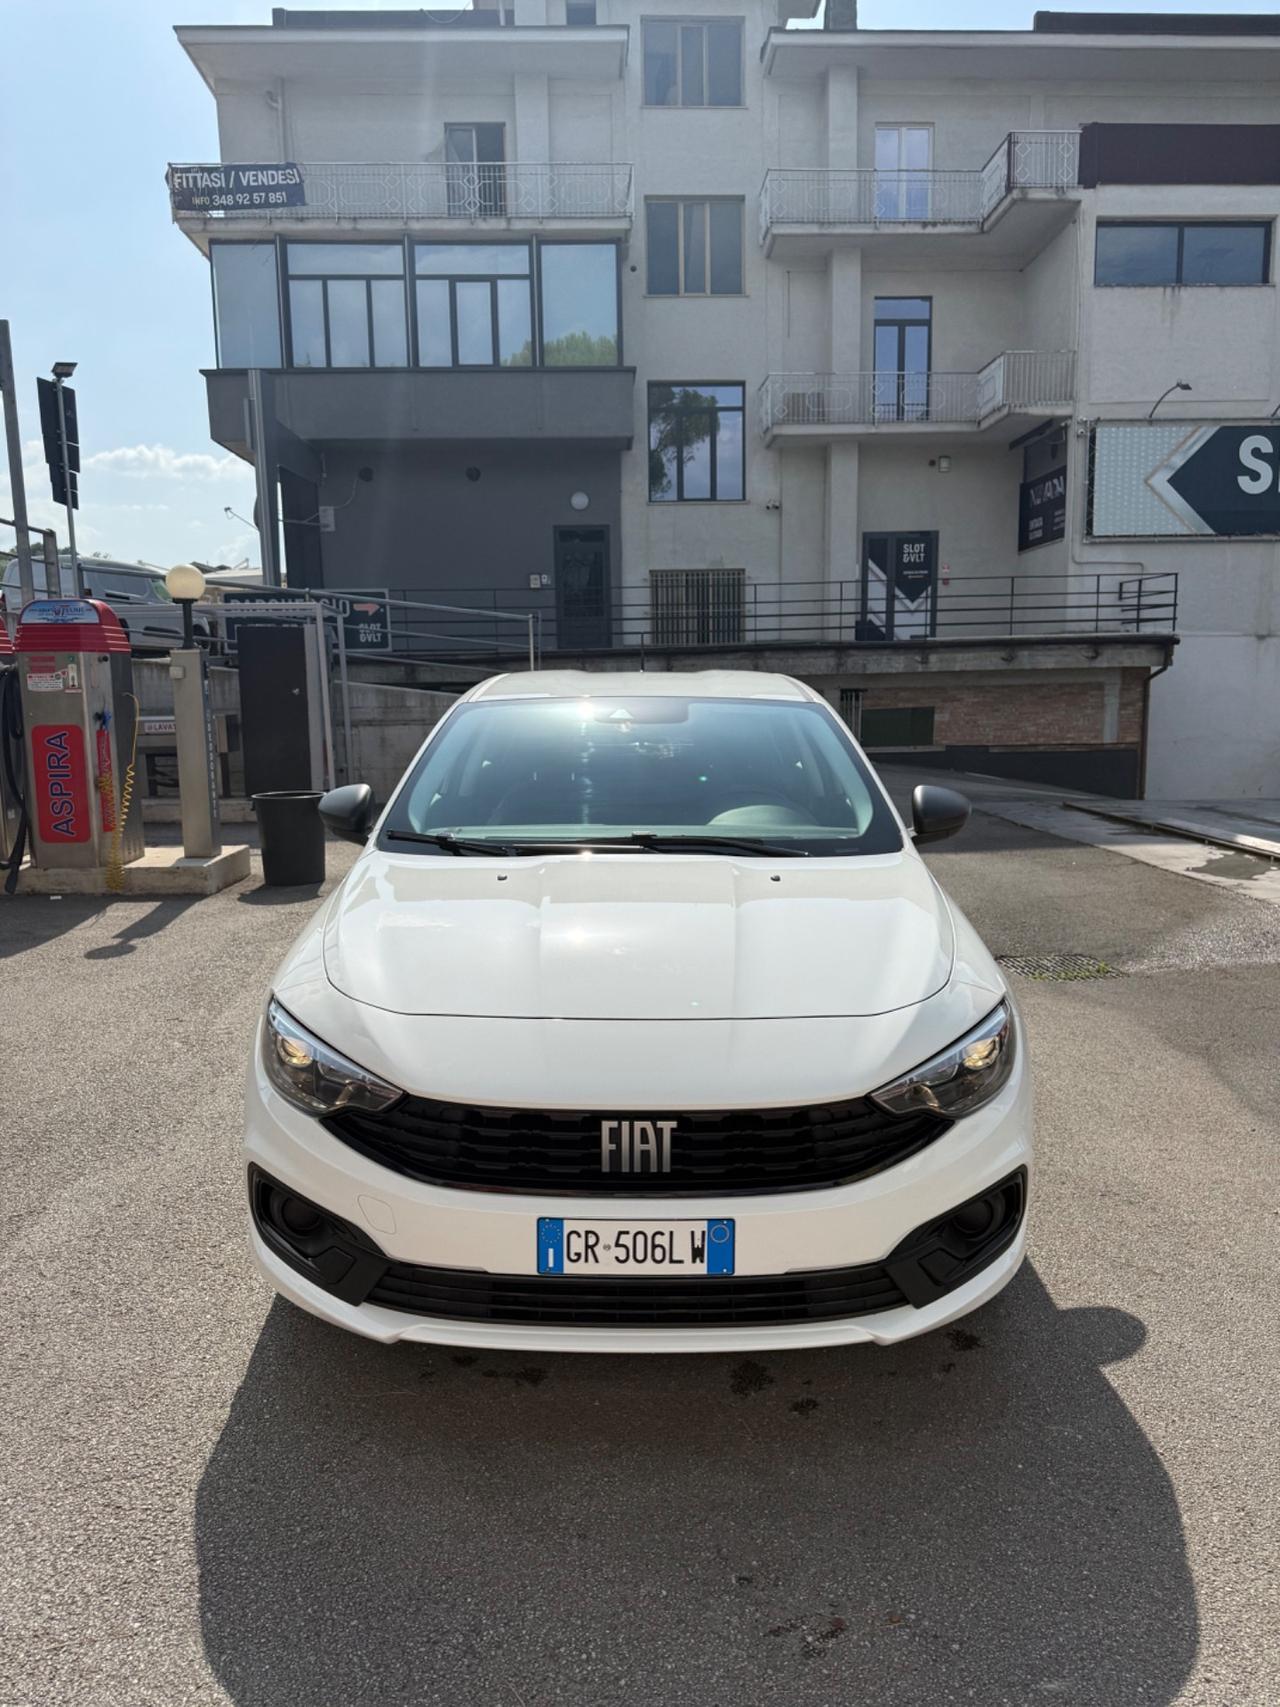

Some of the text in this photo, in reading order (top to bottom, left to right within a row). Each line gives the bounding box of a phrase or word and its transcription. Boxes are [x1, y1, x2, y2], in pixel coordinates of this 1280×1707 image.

[174, 171, 226, 189] FITTASI
[239, 168, 300, 187] VENDESI
[212, 194, 234, 206] 348
[236, 193, 250, 205] 92
[253, 192, 266, 204] 57
[268, 191, 288, 203] 851
[1237, 434, 1280, 495] S
[903, 543, 925, 553] SLOT
[45, 731, 76, 837] ASPIRA
[601, 1120, 678, 1173] FIAT
